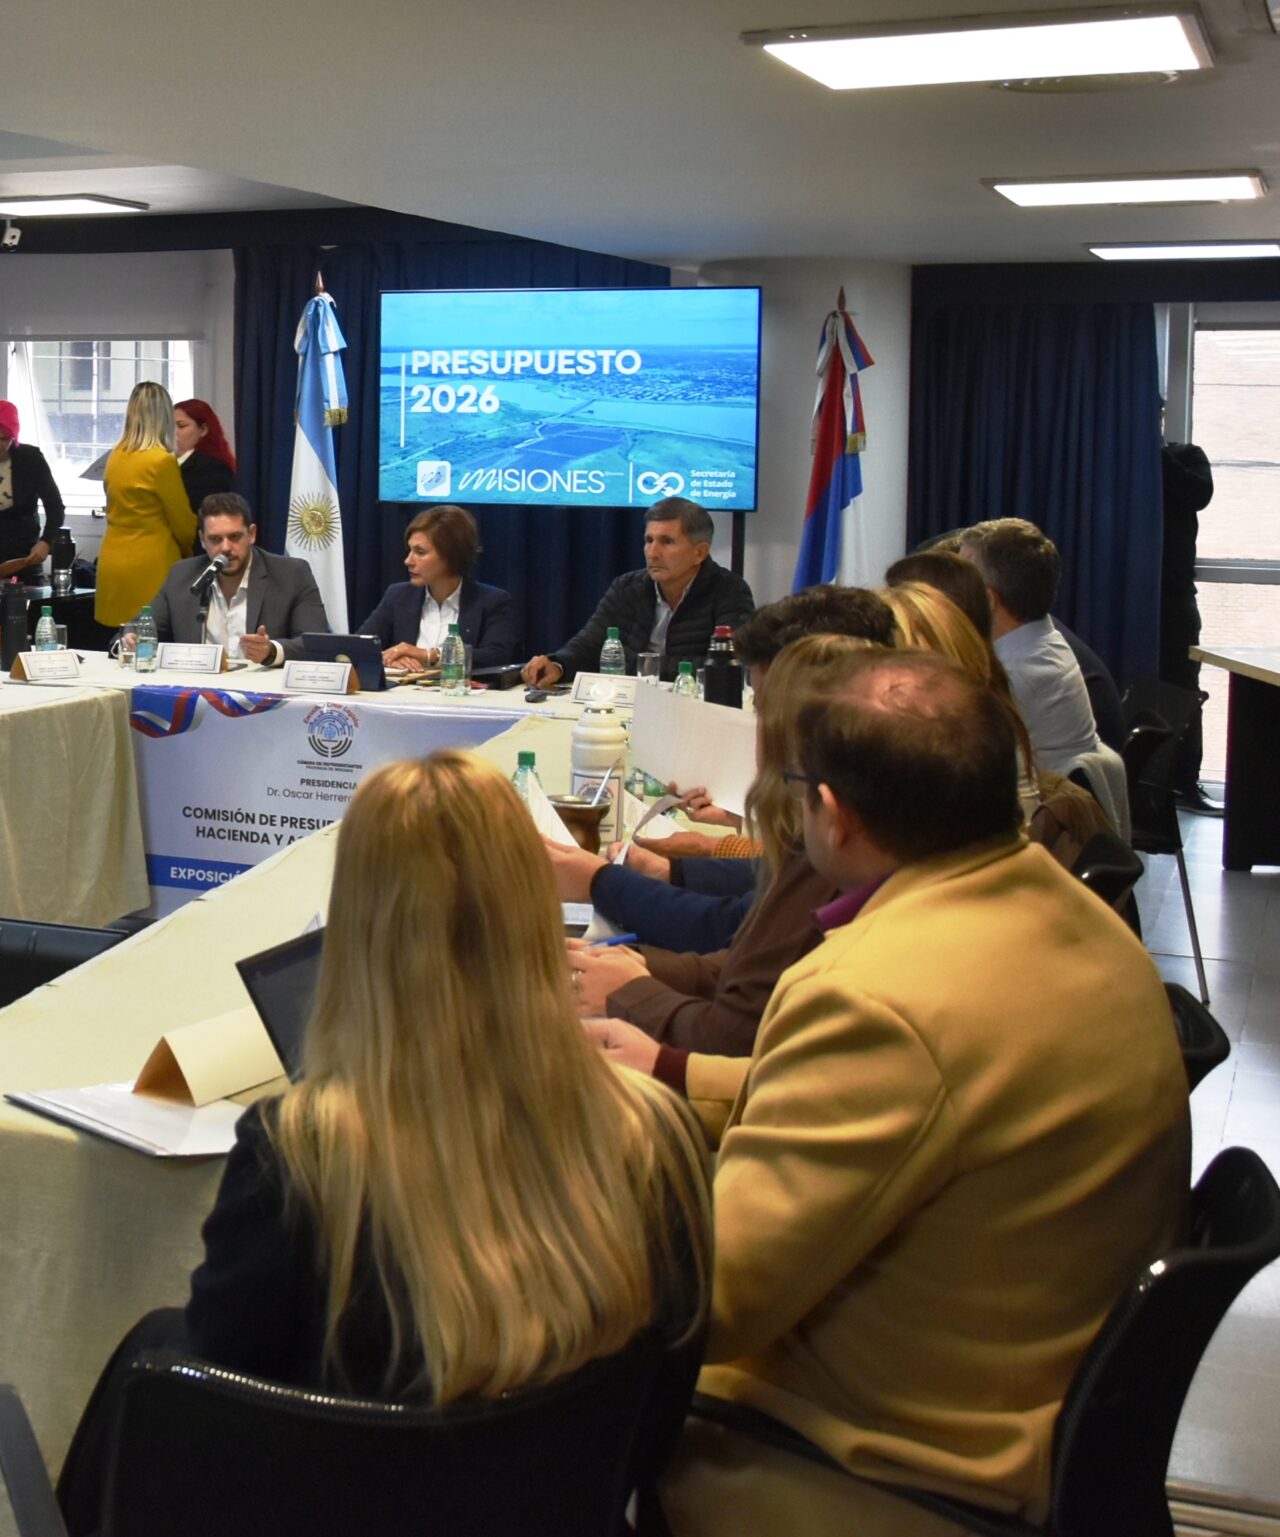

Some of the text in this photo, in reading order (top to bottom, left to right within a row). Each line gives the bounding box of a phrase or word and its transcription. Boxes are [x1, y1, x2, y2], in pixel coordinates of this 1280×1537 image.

[410, 349, 642, 376] PRESUPUESTO
[410, 384, 500, 414] 2026
[458, 468, 606, 494] MISIONES
[690, 469, 736, 478] Secretaría
[690, 480, 734, 488] de Estado
[690, 489, 737, 499] de Energía
[267, 787, 280, 797] Dr.
[282, 788, 313, 800] Oscar
[182, 806, 255, 825] COMISIÓN
[259, 814, 277, 827] DE
[196, 825, 270, 845] HACIENDA
[274, 833, 284, 846] Y
[170, 866, 241, 884] EXPOSICI
